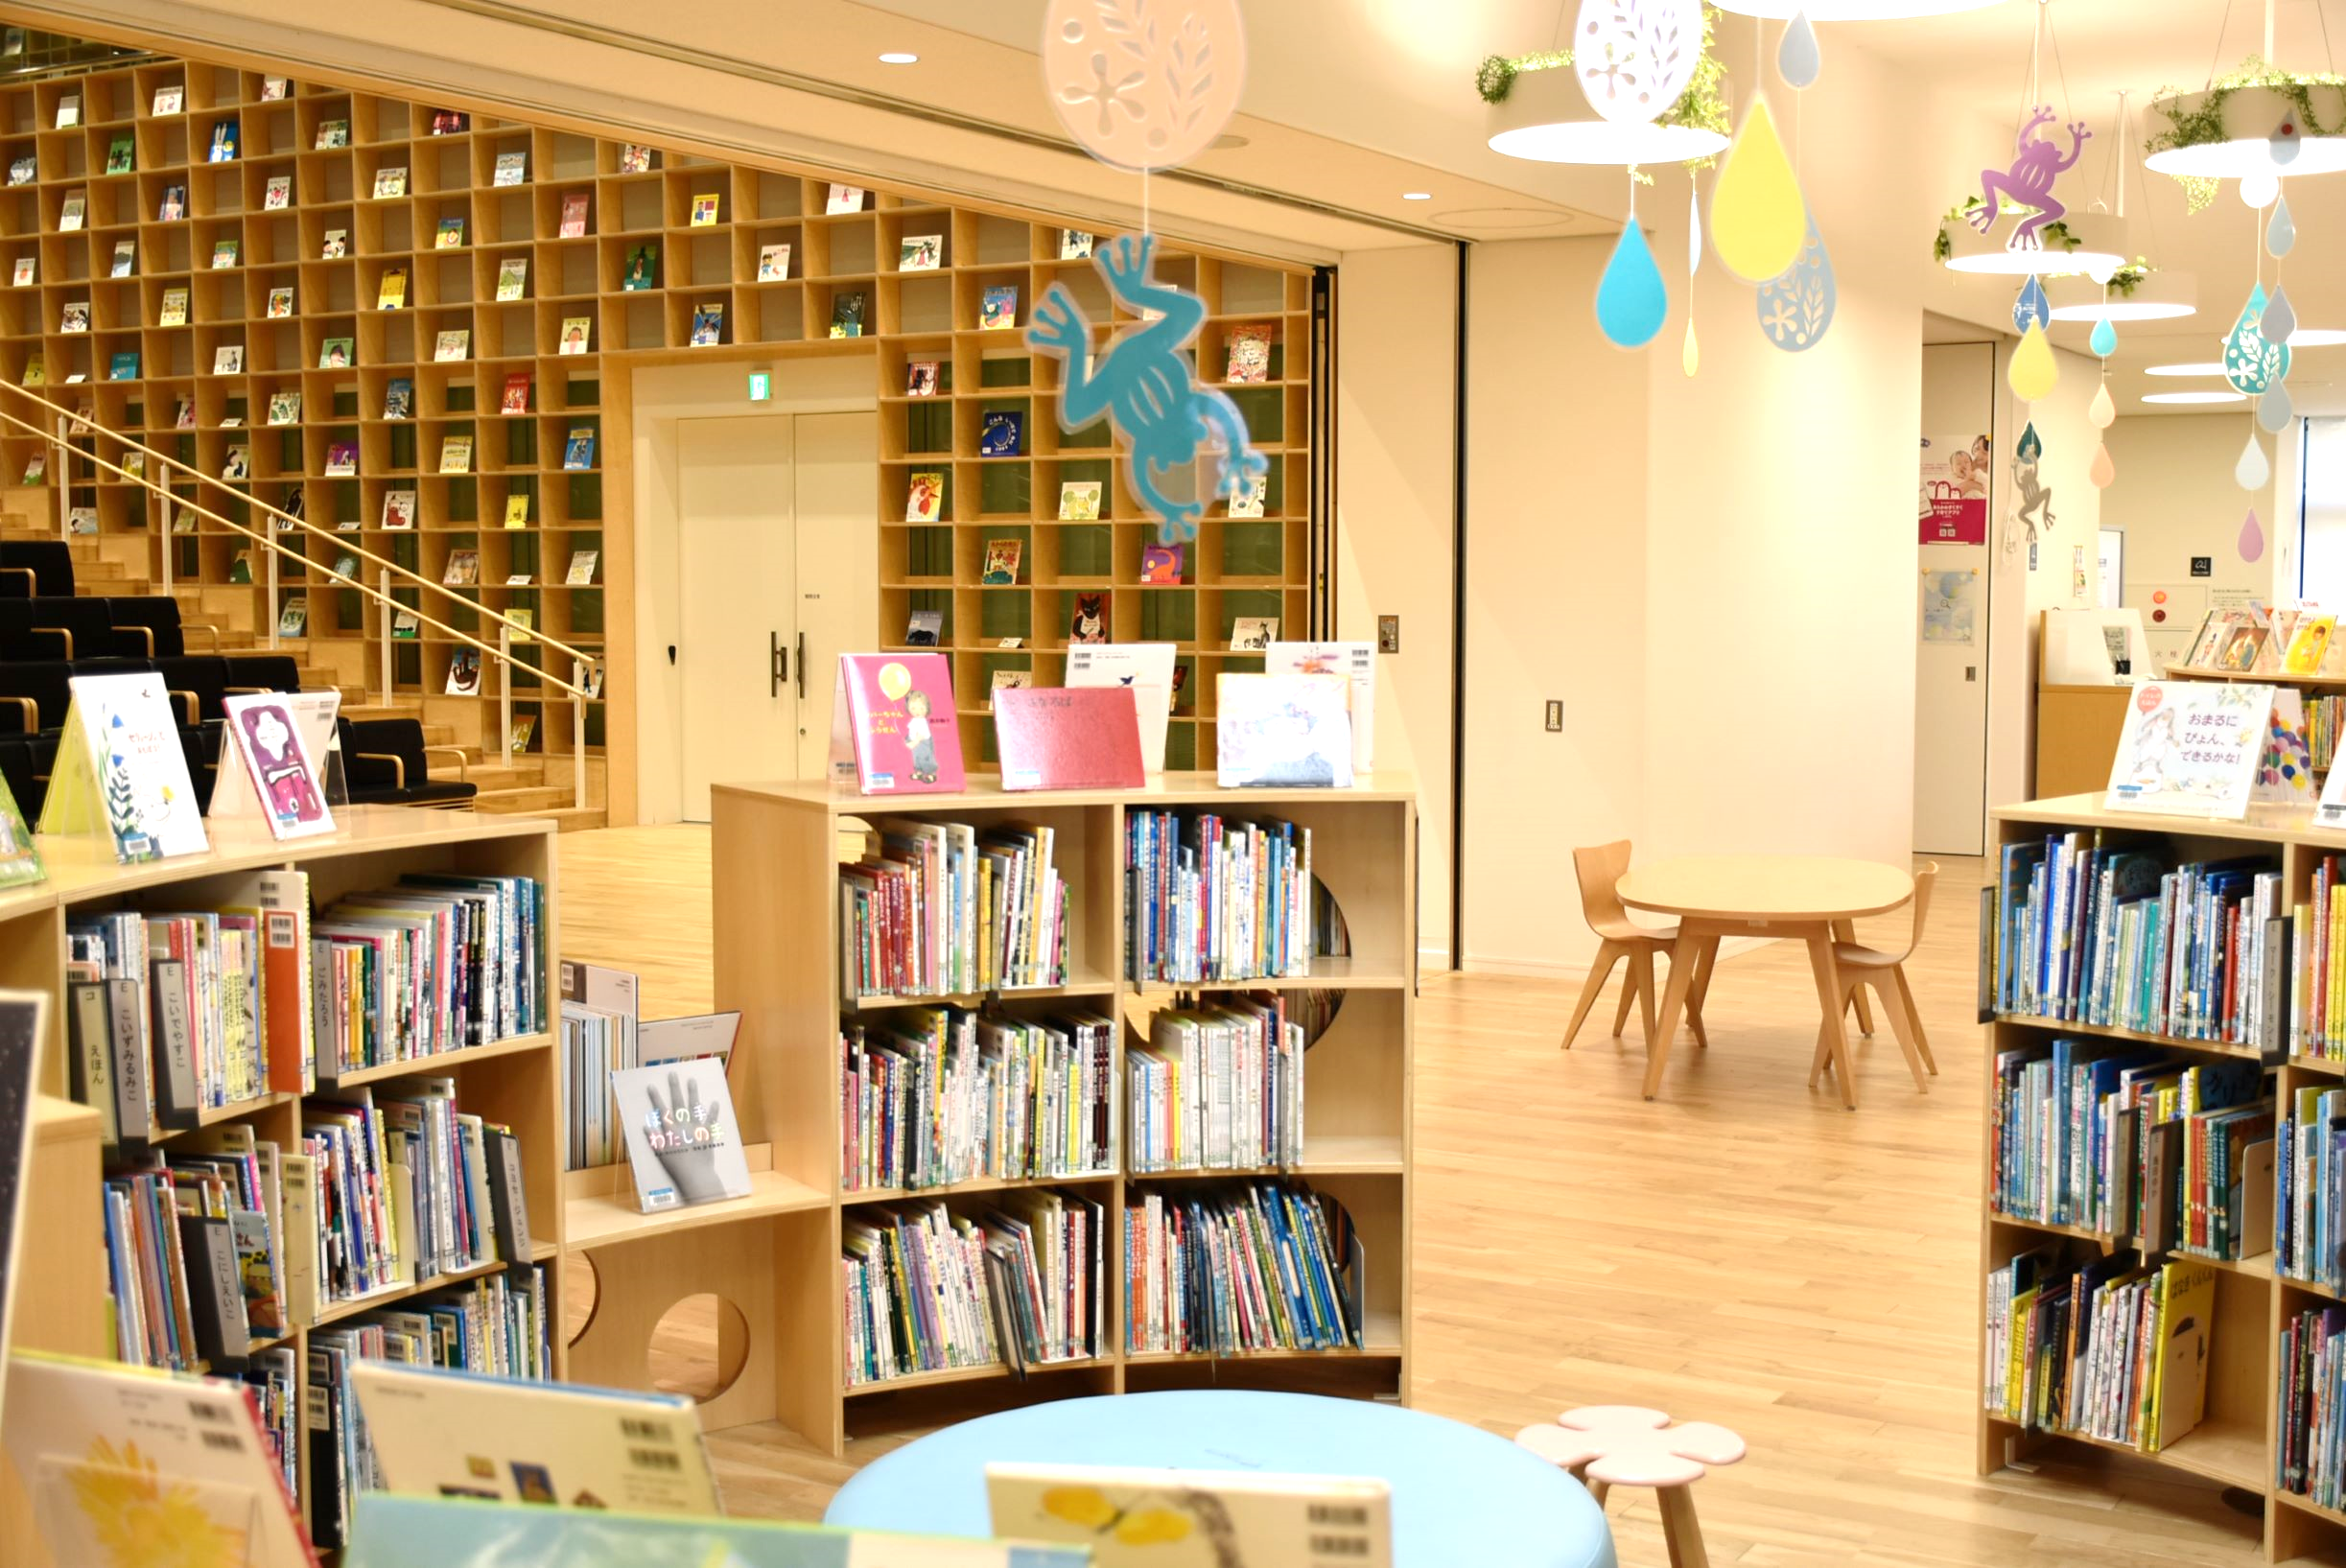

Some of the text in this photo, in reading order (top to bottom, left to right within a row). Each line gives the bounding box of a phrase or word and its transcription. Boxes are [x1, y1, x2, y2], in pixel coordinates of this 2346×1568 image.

[2188, 714, 2240, 727] おまるに
[166, 966, 175, 976] E
[85, 992, 96, 1001] コ
[121, 982, 129, 994] E
[168, 991, 186, 1068] こいでやすこ
[90, 1044, 105, 1086] えほん
[121, 1009, 138, 1102] こいずみるみこ
[645, 1103, 709, 1130] ぼくの手
[649, 1122, 726, 1150] わたしの手
[214, 1227, 222, 1236] E
[217, 1250, 236, 1321] こにしえいこ
